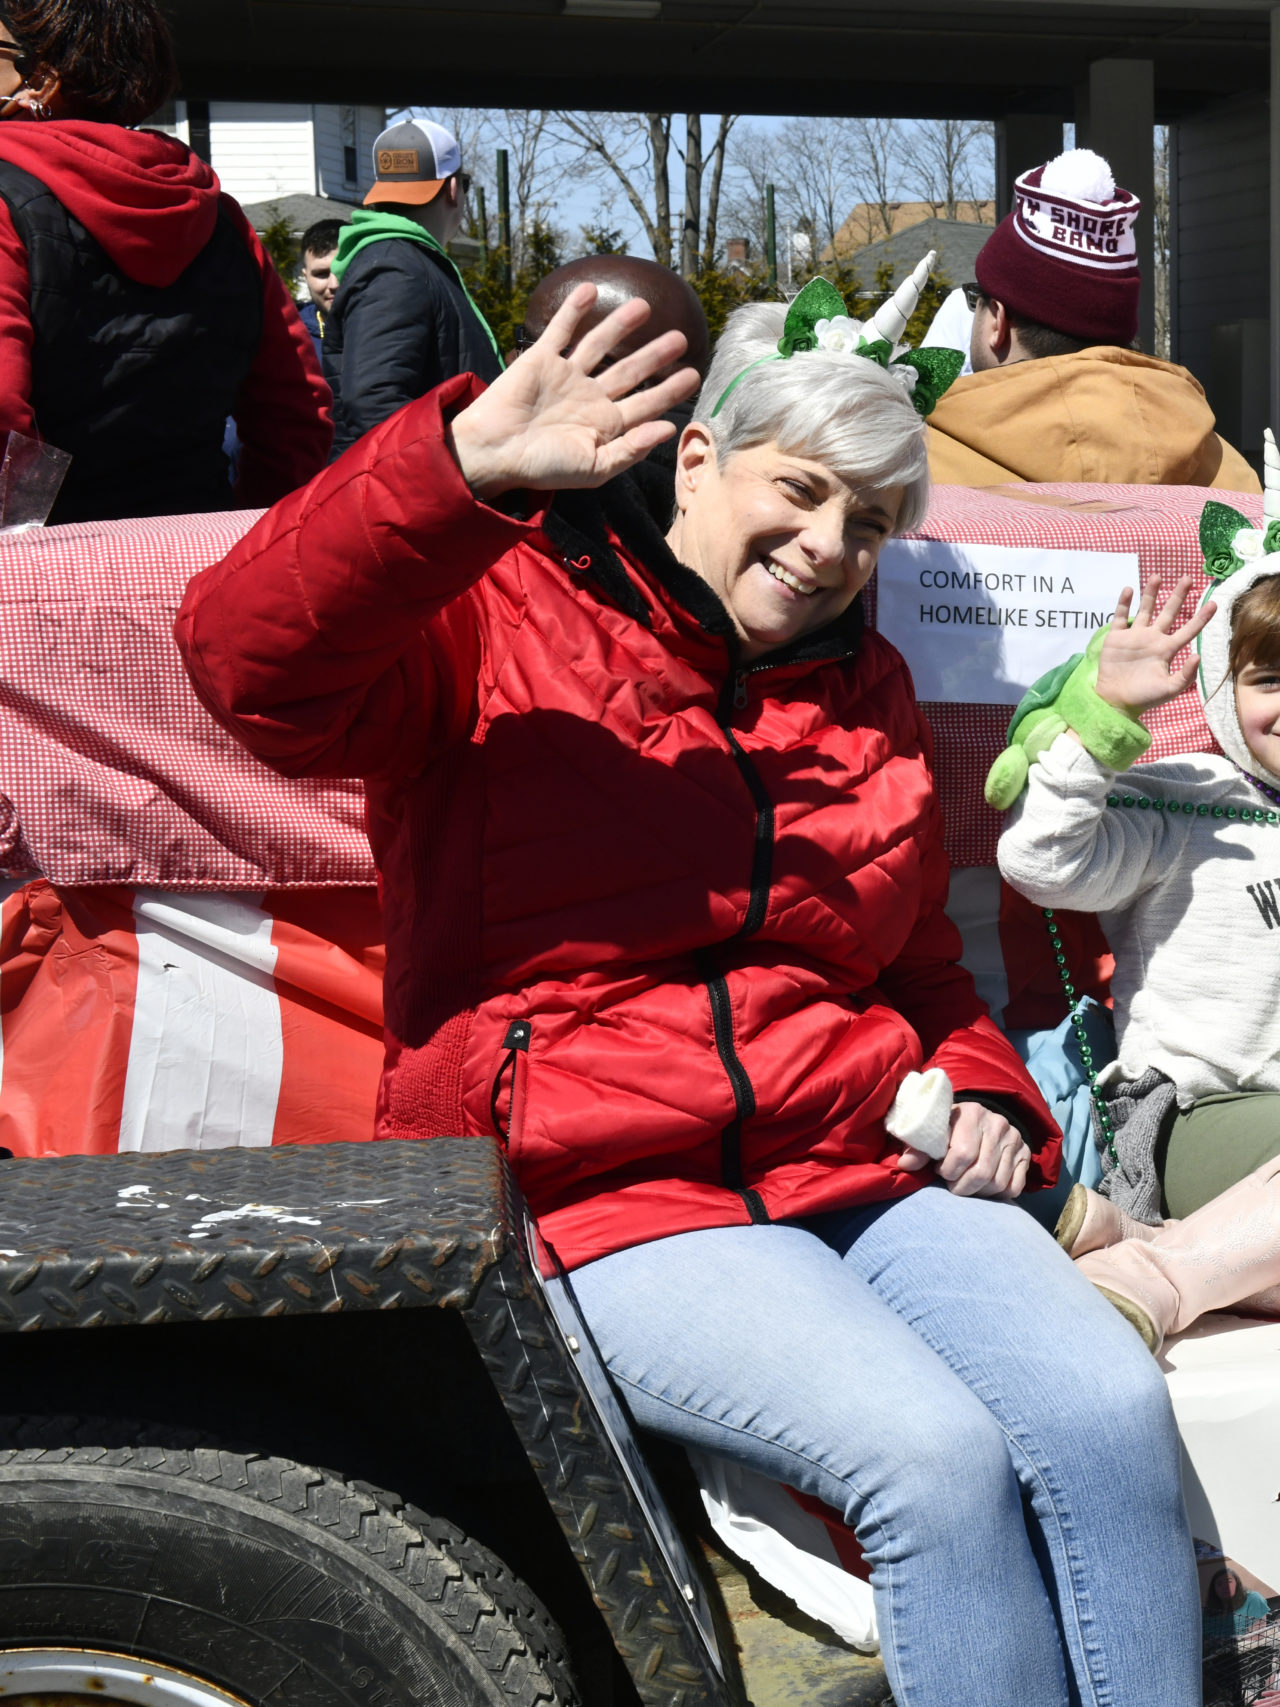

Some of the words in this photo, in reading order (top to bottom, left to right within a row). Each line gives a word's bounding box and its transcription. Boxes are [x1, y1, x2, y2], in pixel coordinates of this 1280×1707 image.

[1050, 206, 1128, 237] SHORE
[1052, 226, 1119, 253] BAND
[919, 569, 1026, 592] COMFORT
[1033, 575, 1053, 593] IN
[1061, 576, 1075, 594] A
[919, 604, 1028, 627] HOMELIKE
